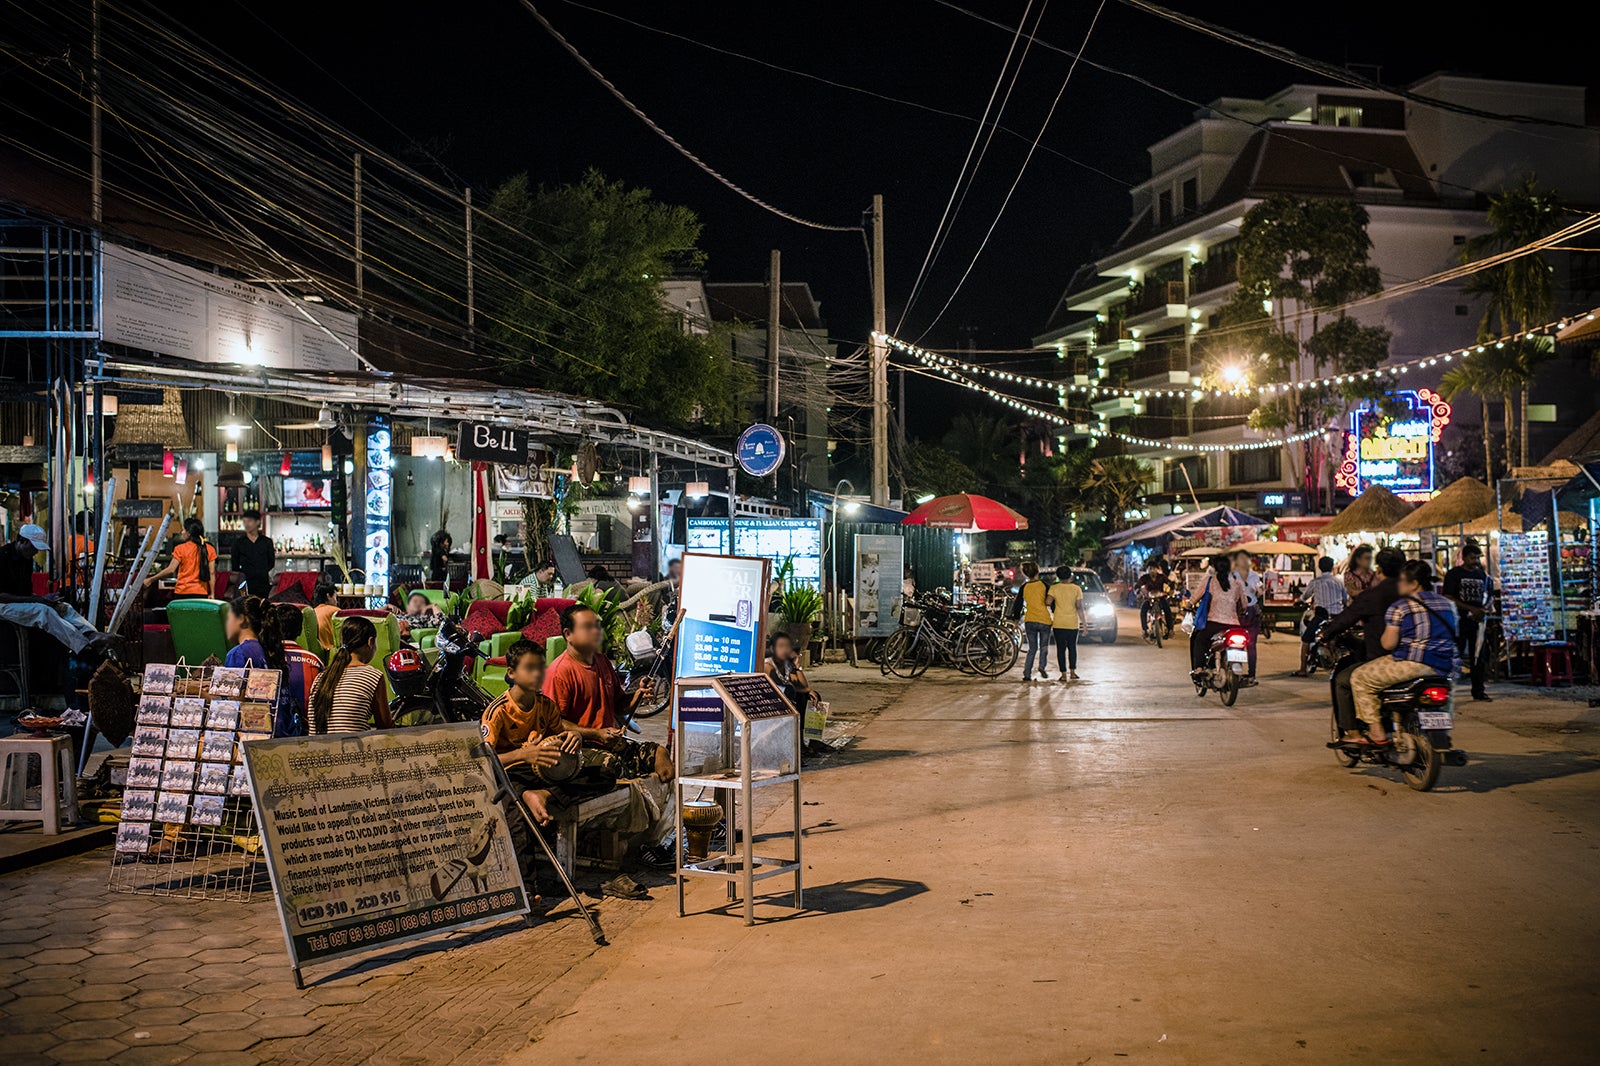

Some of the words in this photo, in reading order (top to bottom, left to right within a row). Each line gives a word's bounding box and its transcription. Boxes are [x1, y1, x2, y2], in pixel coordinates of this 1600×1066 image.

[1264, 494, 1284, 505] ATM
[719, 654, 728, 663] 60
[720, 645, 729, 654] 30
[721, 636, 730, 645] 10
[274, 809, 298, 822] Music
[297, 805, 318, 818] Bend
[319, 804, 327, 816] of
[328, 801, 363, 814] Landmine
[363, 798, 390, 809] Victims
[391, 794, 404, 805] and
[404, 790, 425, 803] street
[425, 788, 452, 799] Children
[452, 784, 488, 796] Association
[276, 822, 301, 837] Would
[302, 821, 317, 832] like
[317, 820, 327, 831] to
[327, 816, 352, 831] appeal
[353, 814, 361, 826] to
[361, 812, 377, 824] deal
[378, 810, 391, 821] and
[391, 804, 437, 820] internationals
[437, 801, 456, 814] guest
[456, 799, 464, 809] to
[464, 798, 476, 809] buy
[281, 837, 315, 854] products
[316, 833, 334, 847] such
[335, 832, 344, 843] as
[345, 824, 388, 842] CD,VCD,DVD
[389, 822, 402, 834] and
[402, 820, 421, 832] other
[421, 813, 448, 828] musical
[447, 809, 485, 823] instruments
[284, 853, 308, 867] which
[309, 851, 322, 863] are
[323, 847, 345, 860] made
[344, 846, 354, 859] by
[355, 844, 368, 855] the
[368, 836, 412, 854] handicapped
[412, 834, 421, 844] or
[420, 832, 429, 842] to
[429, 829, 453, 844] provide
[453, 825, 472, 837] either
[287, 865, 321, 881] financial
[322, 860, 355, 877] supports
[355, 859, 364, 870] or
[364, 853, 390, 868] musical
[391, 847, 433, 864] instruments
[432, 845, 441, 855] to
[440, 843, 459, 855] them
[291, 884, 314, 897] Since
[314, 880, 332, 893] they
[333, 878, 346, 889] are
[346, 876, 363, 888] very
[363, 870, 399, 885] important
[398, 865, 409, 877] for
[408, 862, 427, 875] their
[299, 905, 324, 922] 1CD
[325, 900, 349, 918] $10
[355, 894, 380, 911] 2CD
[380, 889, 401, 907] $16
[307, 934, 330, 952] Tel:
[329, 929, 349, 948] 097
[363, 923, 377, 940] 33
[376, 918, 396, 937] 699
[400, 914, 420, 931] 089
[419, 910, 432, 927] 61
[431, 908, 445, 923] 66
[444, 905, 456, 921] 69
[460, 900, 478, 917] 096
[477, 897, 490, 913] 23
